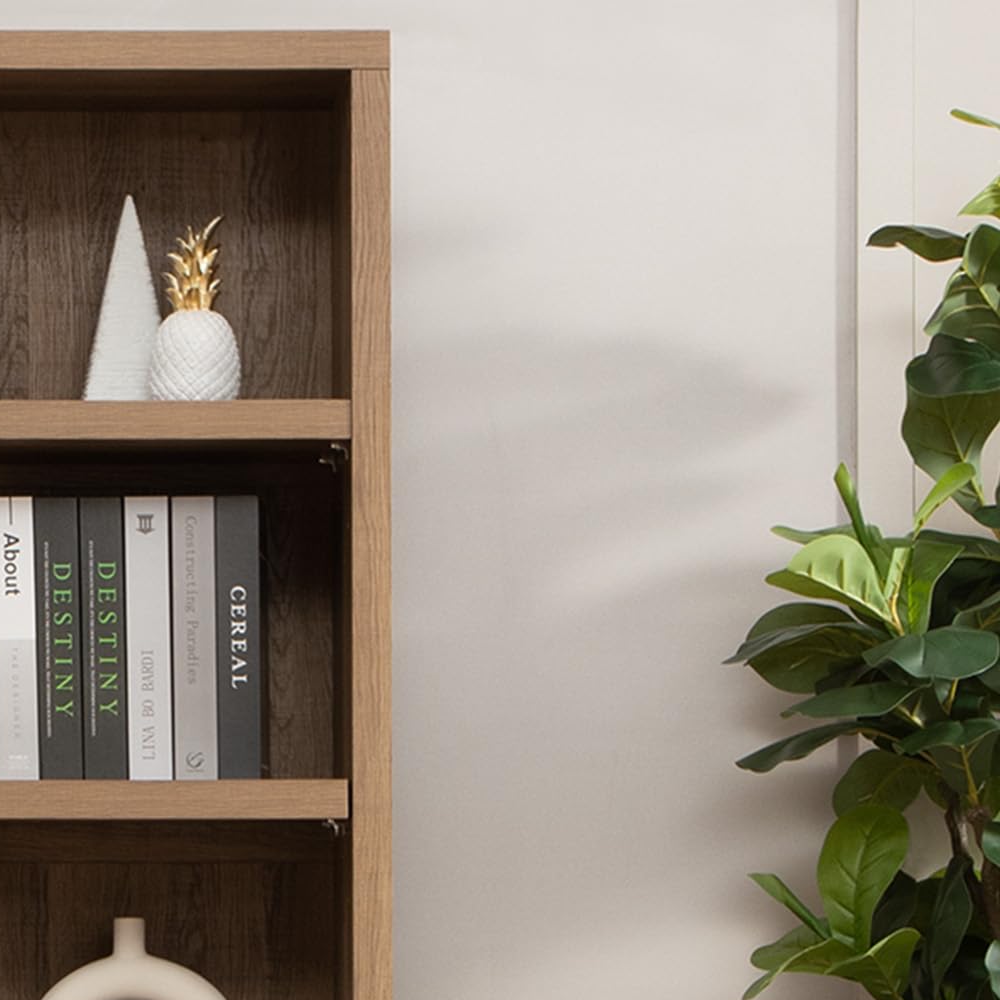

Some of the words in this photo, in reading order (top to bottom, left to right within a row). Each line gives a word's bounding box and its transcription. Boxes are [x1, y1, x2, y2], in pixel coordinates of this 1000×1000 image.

[2, 533, 21, 597] About
[185, 515, 198, 614] Constructing
[52, 562, 74, 718] DESTINY
[96, 561, 119, 717] DESTINY
[141, 649, 154, 692] BARDI
[229, 585, 248, 689] CEREAL
[142, 699, 155, 718] BO
[142, 725, 155, 761] LINA
